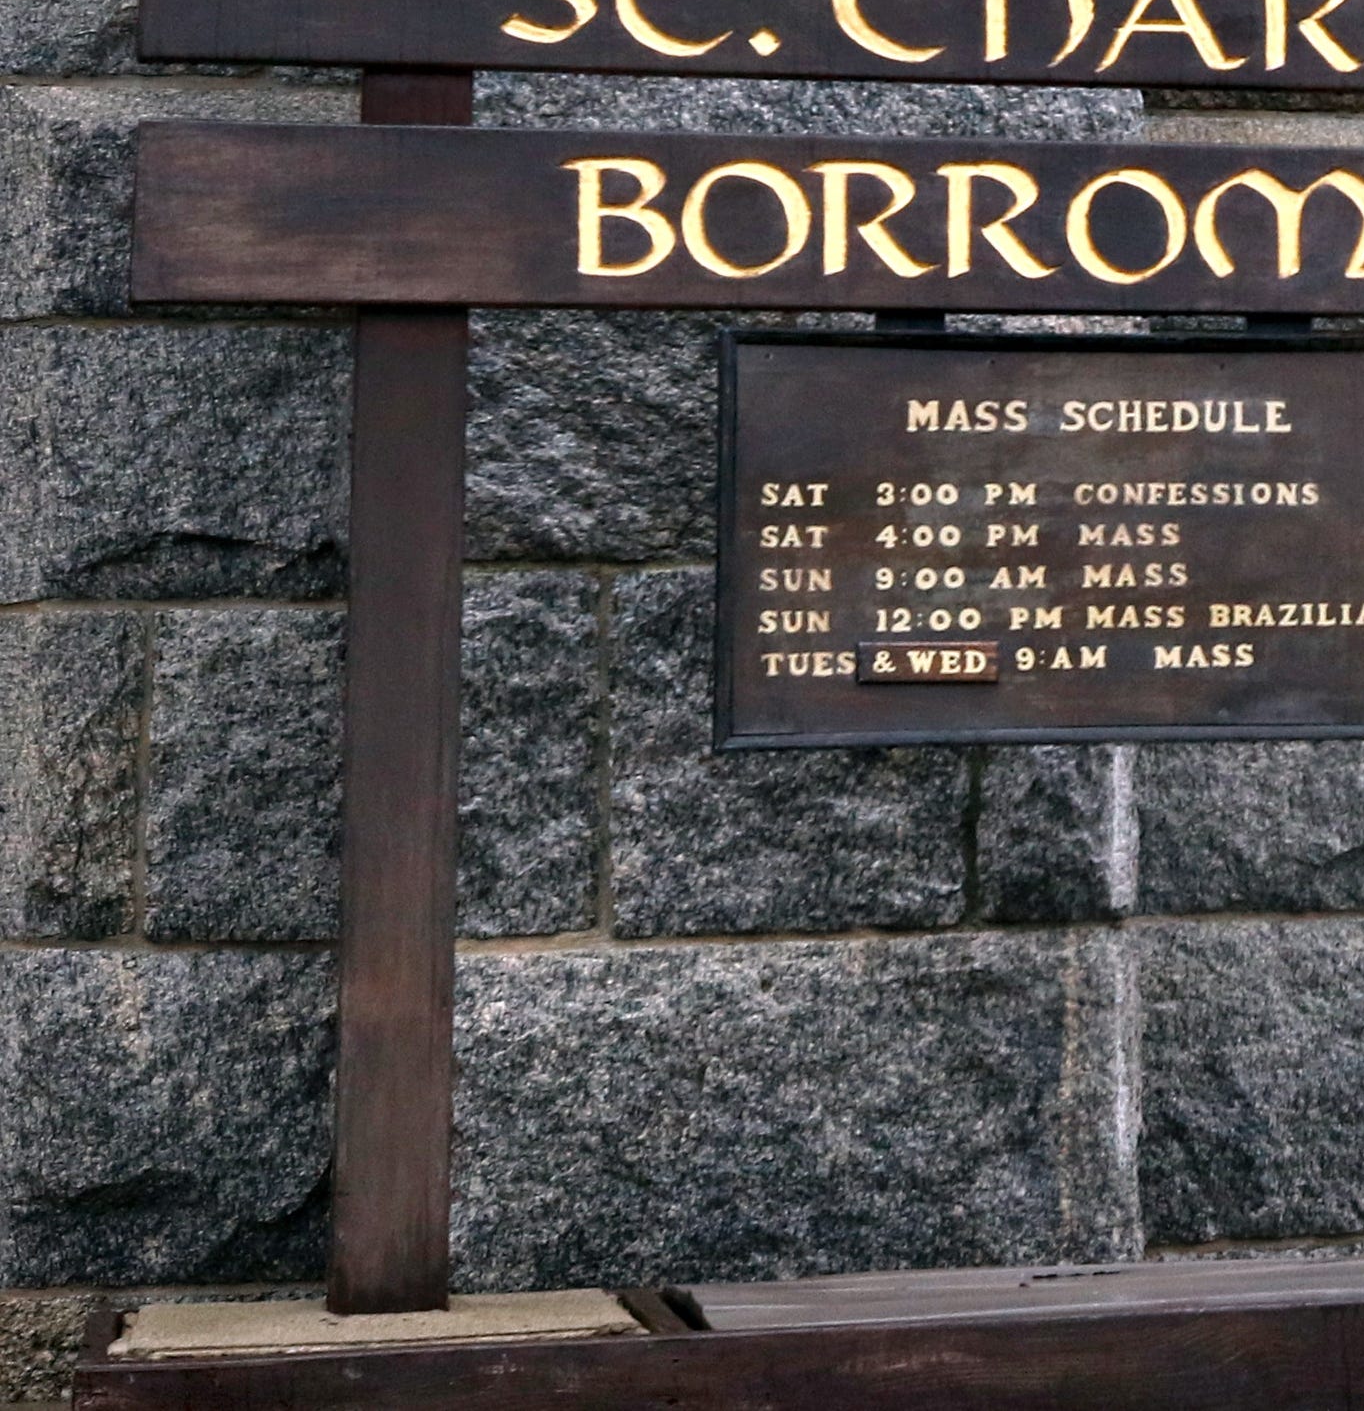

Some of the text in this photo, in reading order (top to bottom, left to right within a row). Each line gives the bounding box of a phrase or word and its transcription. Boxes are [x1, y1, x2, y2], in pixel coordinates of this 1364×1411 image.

[906, 399, 1292, 433] MASS SCHEDULE
[761, 482, 1319, 507] SAT 3:00 PM CONFESSIONS
[760, 523, 1180, 549] SAT 4:00 PM MASS
[759, 562, 1188, 592] SUN 9:00 AM MASS
[758, 610, 830, 634] SUN
[876, 607, 982, 633] 12:00
[1009, 606, 1064, 631] PM
[1086, 605, 1185, 630] MASS
[761, 651, 856, 677] TUES
[872, 650, 897, 673] &
[906, 649, 987, 674] WED
[1153, 643, 1254, 669] MASS
